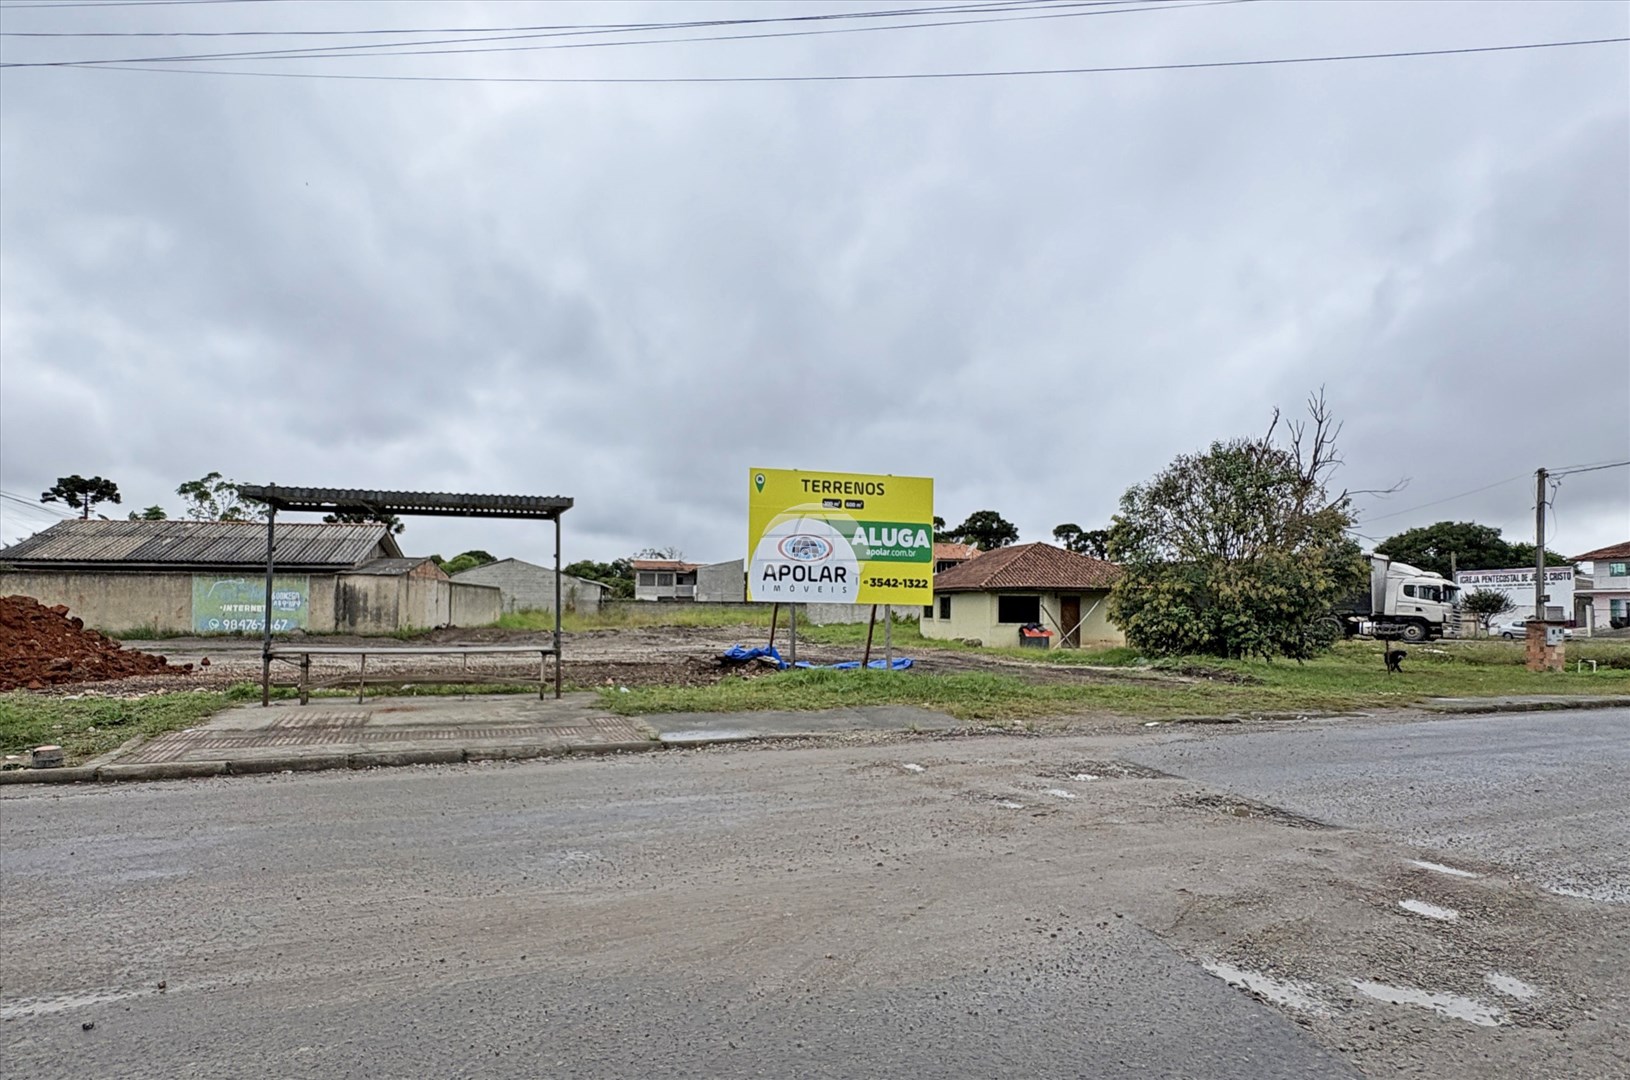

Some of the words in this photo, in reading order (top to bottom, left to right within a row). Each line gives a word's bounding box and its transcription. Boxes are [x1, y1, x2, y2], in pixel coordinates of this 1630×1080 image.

[801, 479, 885, 496] TERRENOS
[851, 527, 930, 548] ALUGA
[866, 548, 916, 558] apolar.com.br
[763, 564, 846, 583] APOLAR
[1460, 575, 1480, 584] IGREJA
[1481, 573, 1520, 583] PENTECOSTAL
[1521, 573, 1529, 582] DE
[1530, 573, 1548, 582] JES
[1550, 572, 1571, 581] CRISTO
[762, 584, 847, 593] IMÓVEIS
[869, 577, 929, 589] 3542-1322
[222, 619, 288, 630] 98476-767
